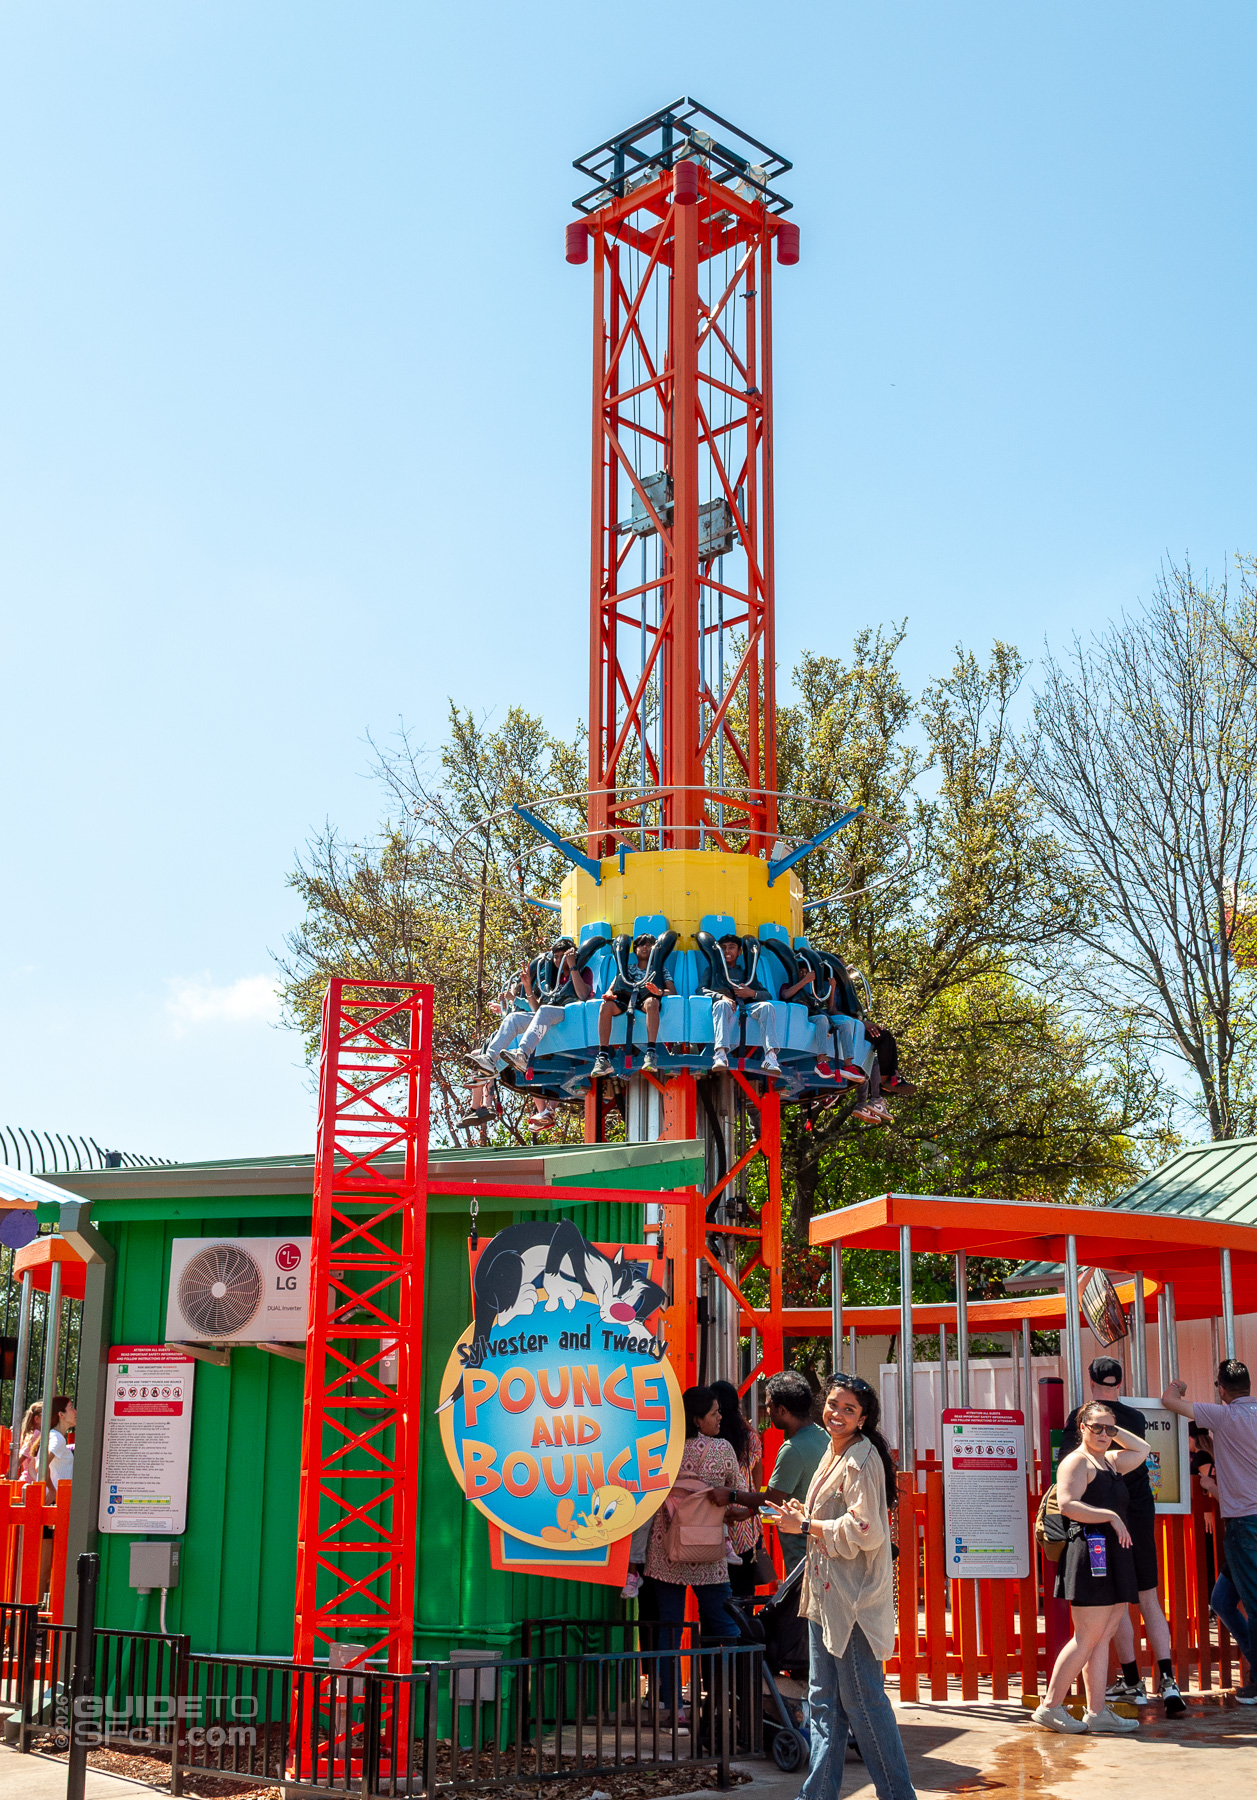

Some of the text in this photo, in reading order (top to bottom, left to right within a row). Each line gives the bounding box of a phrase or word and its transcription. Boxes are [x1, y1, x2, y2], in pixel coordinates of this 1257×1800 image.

[276, 1276, 297, 1290] LG
[456, 1323, 669, 1365] Sylvester and Tweety
[462, 1362, 667, 1428] POUNCE
[531, 1414, 601, 1448] AND
[1144, 1421, 1171, 1431] OME TO
[461, 1428, 671, 1501] BOUNCE
